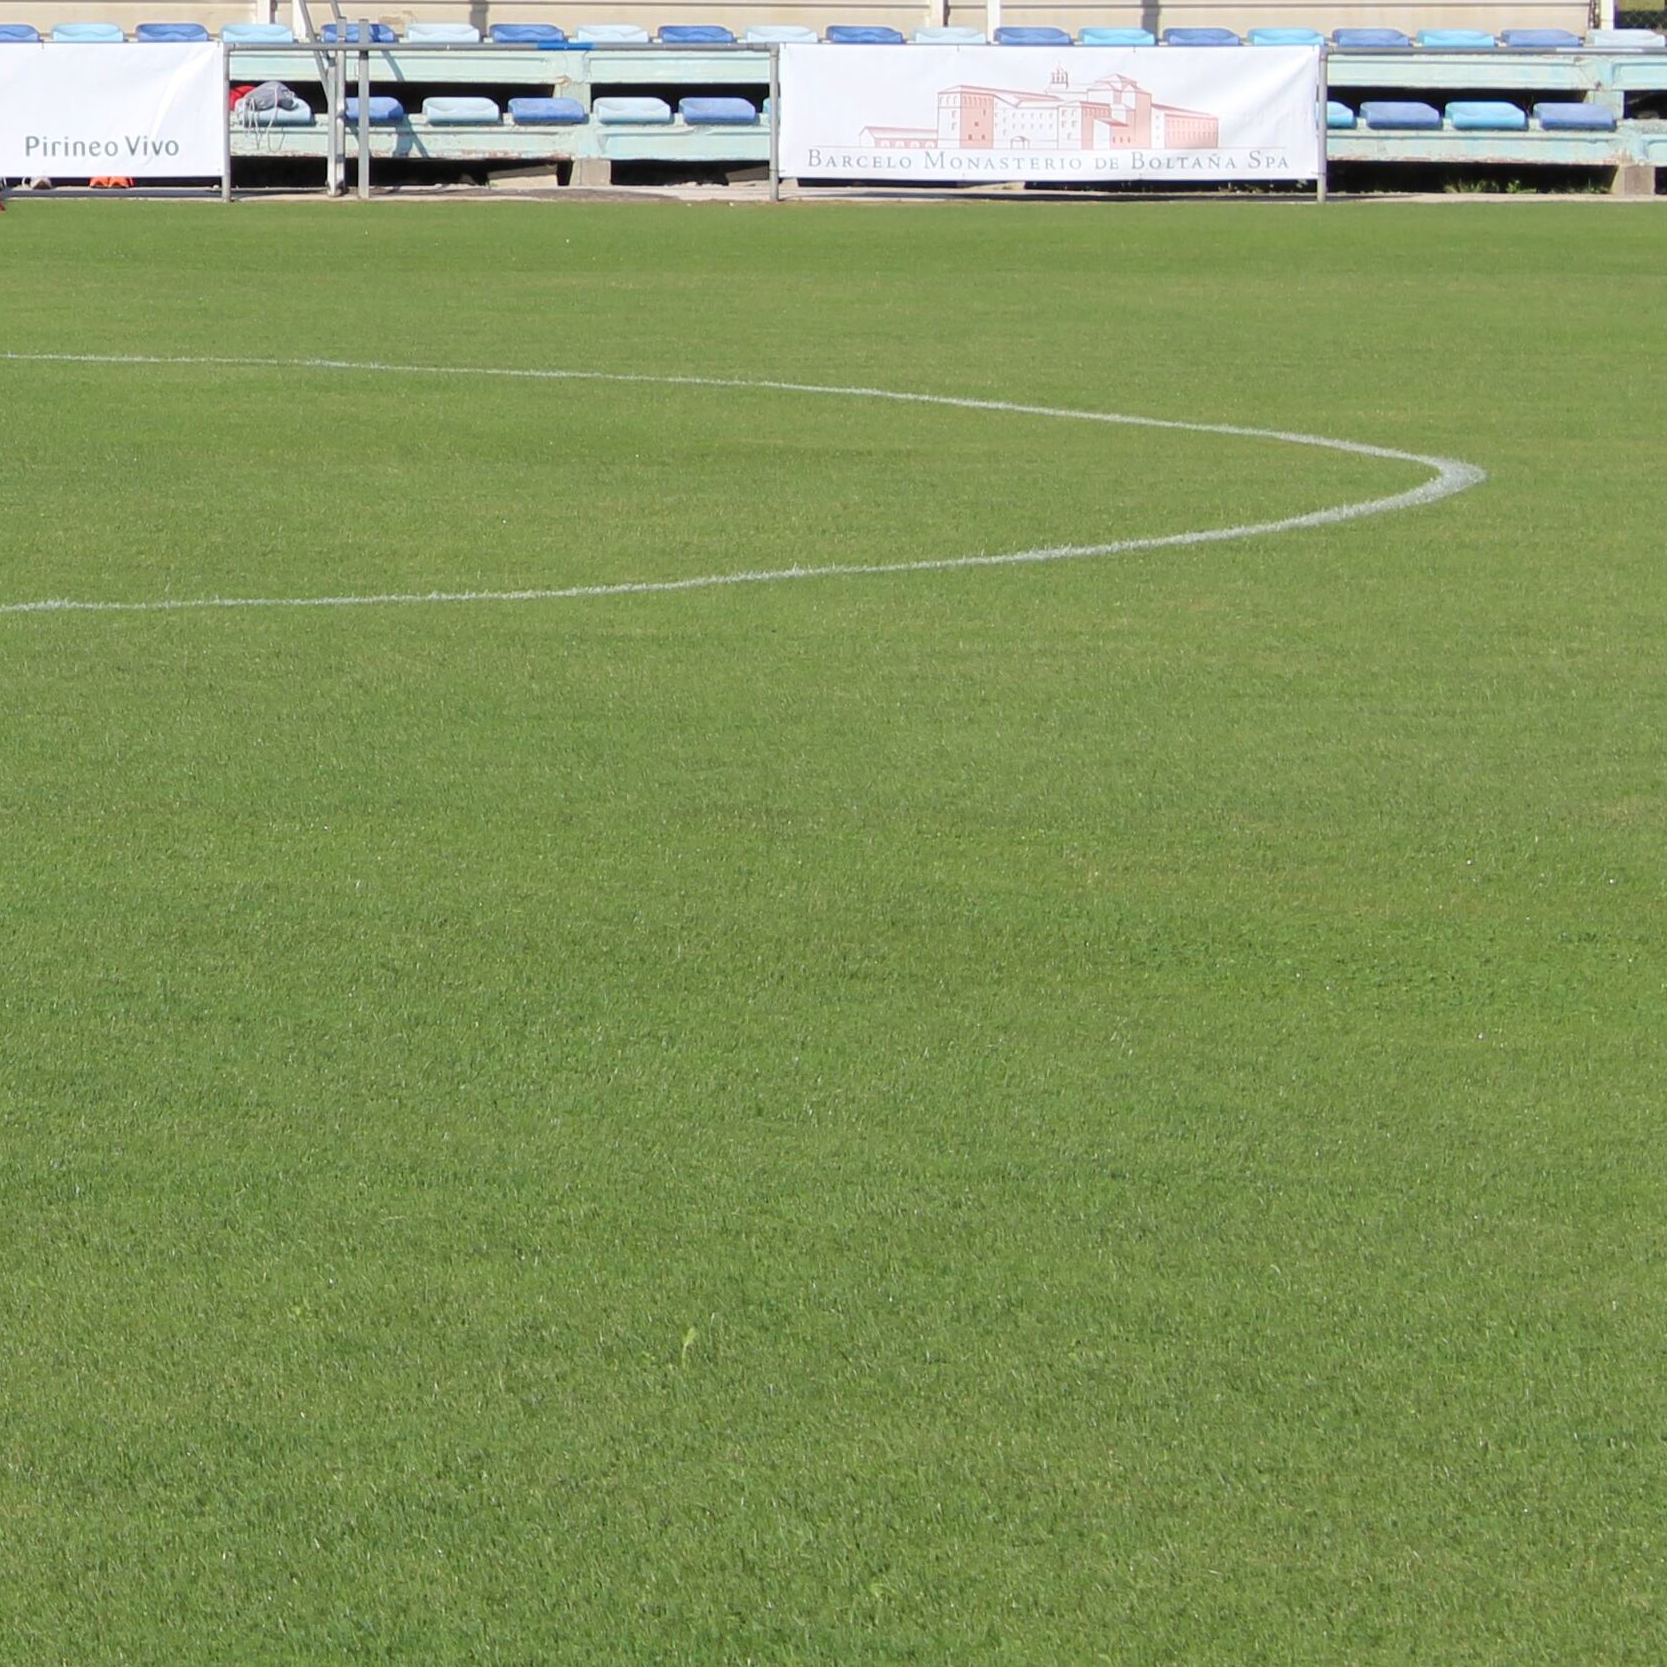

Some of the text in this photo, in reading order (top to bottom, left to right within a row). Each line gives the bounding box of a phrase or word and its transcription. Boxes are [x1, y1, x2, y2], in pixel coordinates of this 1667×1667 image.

[25, 135, 179, 157] Pirineo Vivo
[923, 151, 1082, 170] MONASTERIO
[1095, 157, 1119, 170] DE
